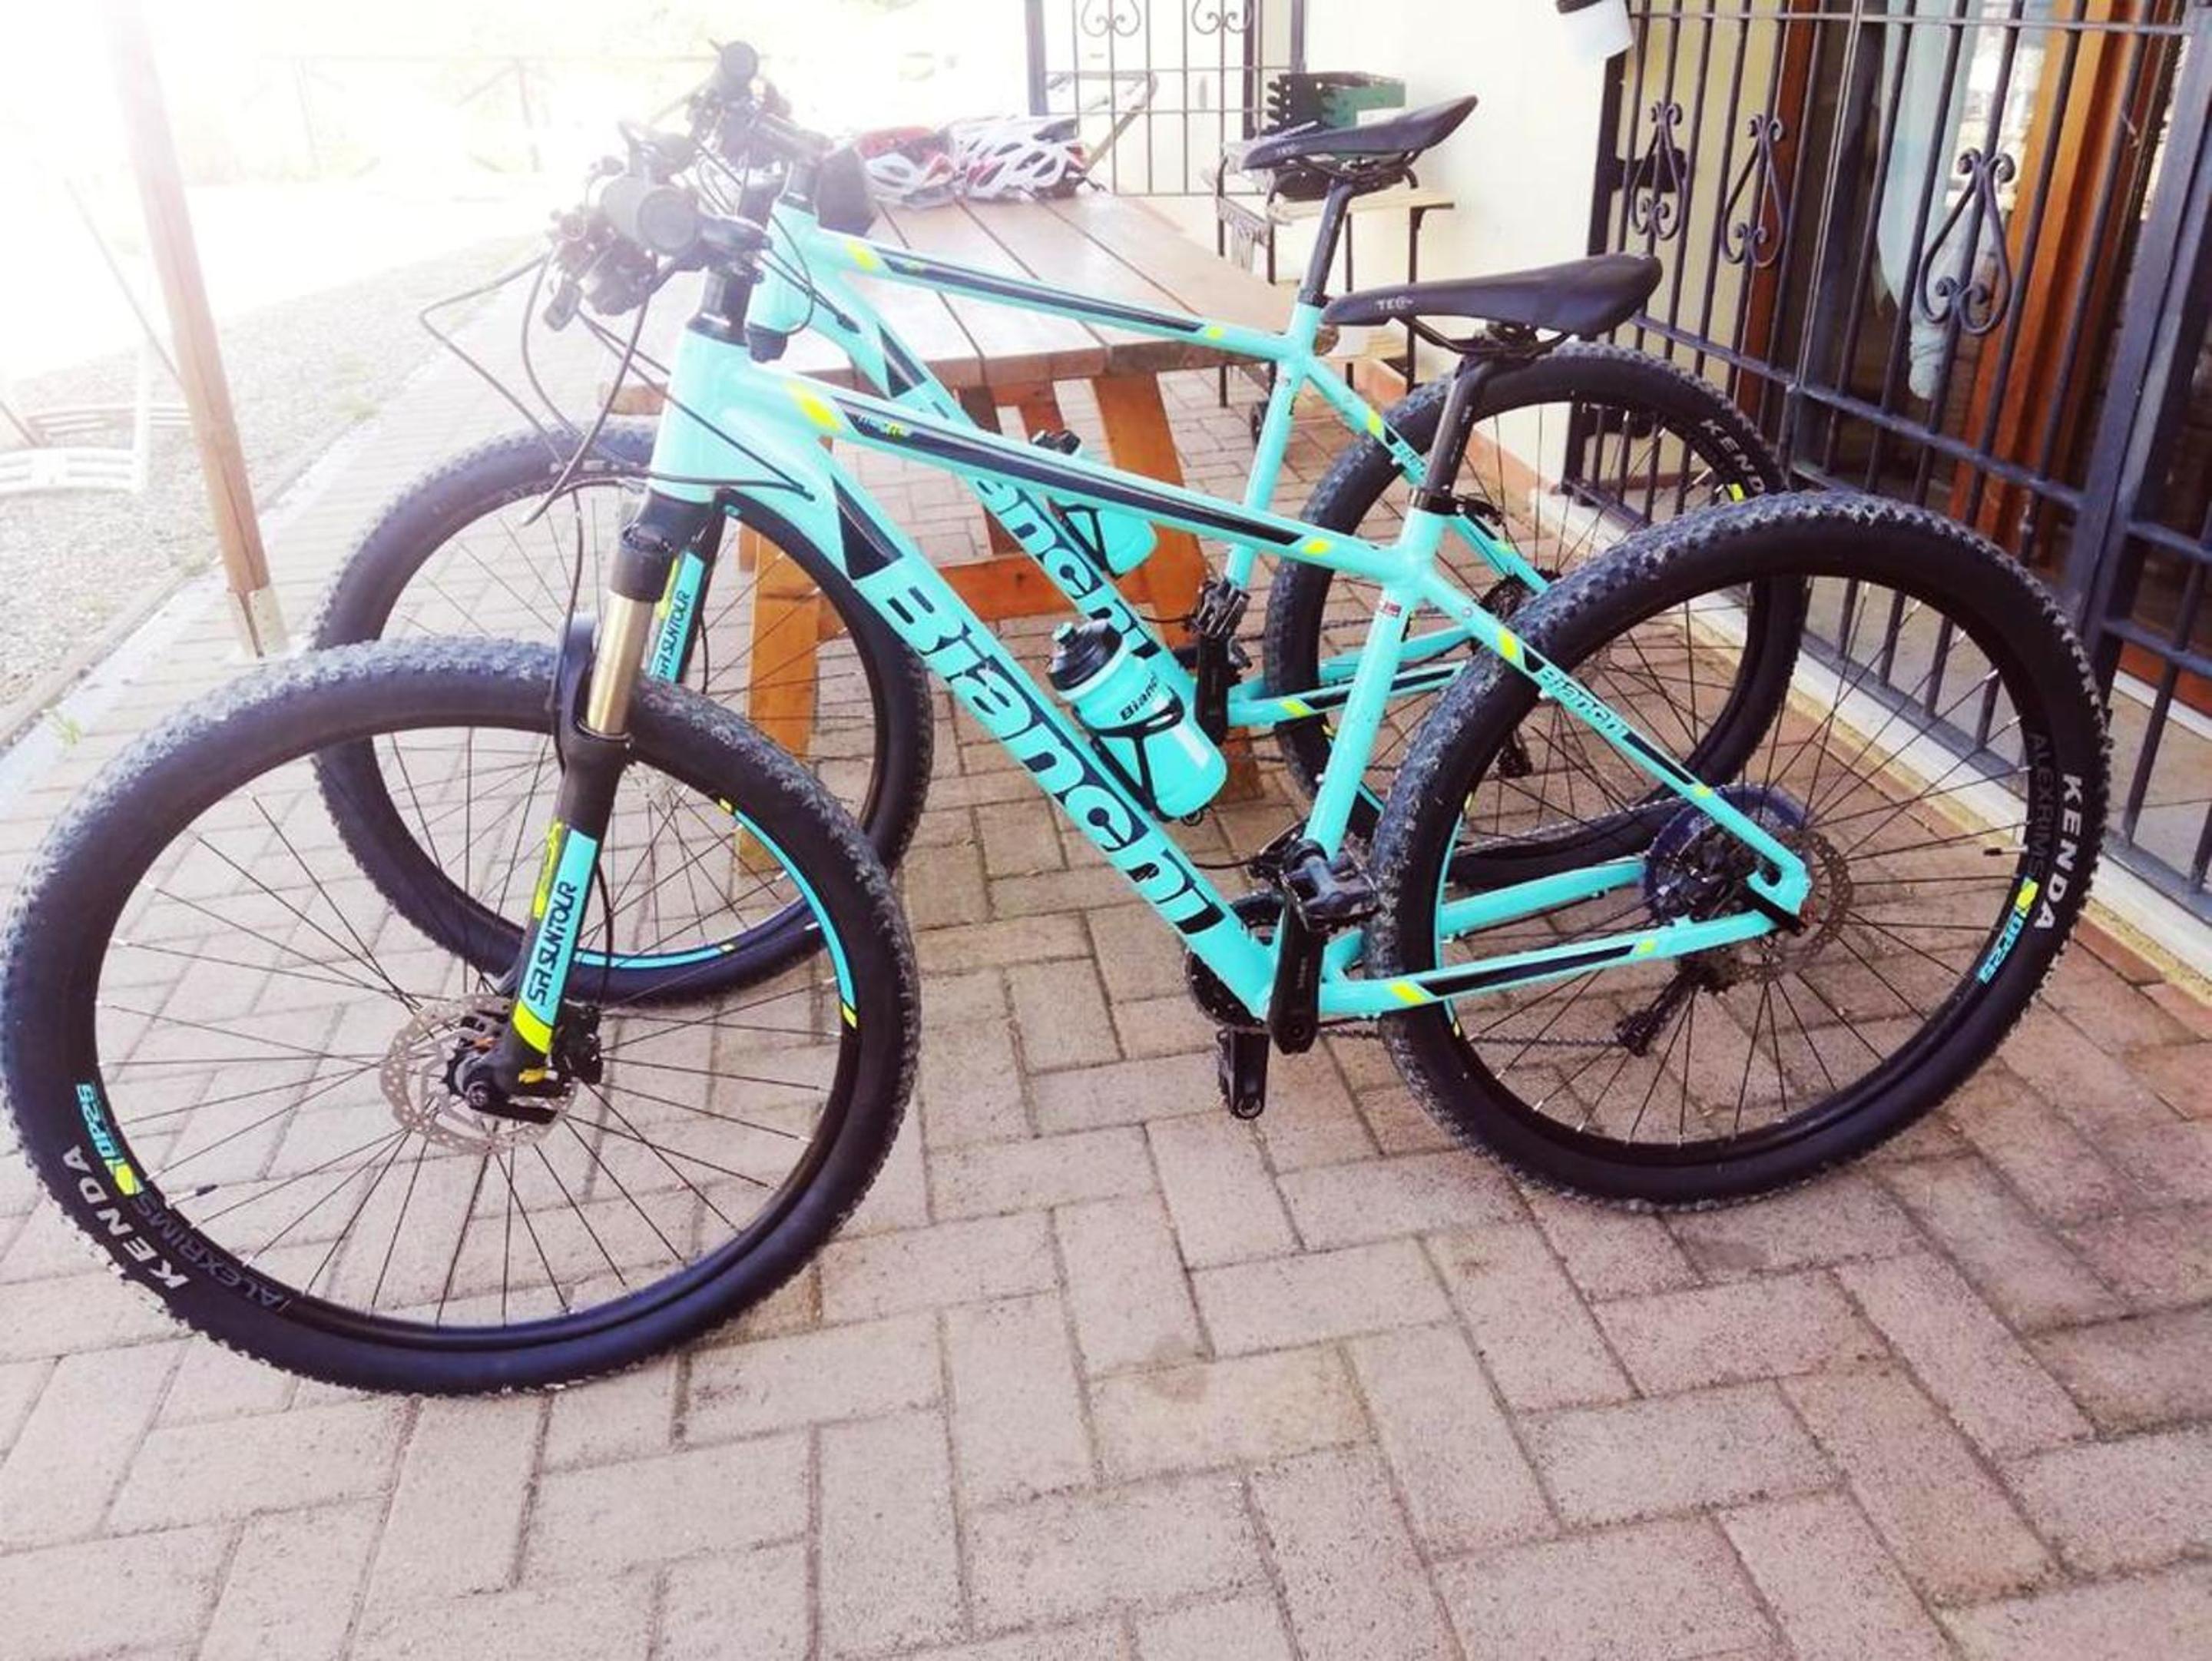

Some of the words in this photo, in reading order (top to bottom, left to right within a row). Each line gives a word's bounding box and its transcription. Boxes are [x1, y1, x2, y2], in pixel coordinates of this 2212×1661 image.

[1700, 419, 1765, 494] KEND
[661, 590, 690, 655] SUNTOUR
[859, 559, 1223, 928] Bianchi
[1537, 665, 1631, 739] Bianchi
[2035, 774, 2083, 929] KENDA
[538, 881, 577, 970] SUNTOUR
[527, 967, 552, 1006] SR
[62, 1144, 190, 1289] KENDA
[132, 1192, 284, 1307] ALEXRIMS
